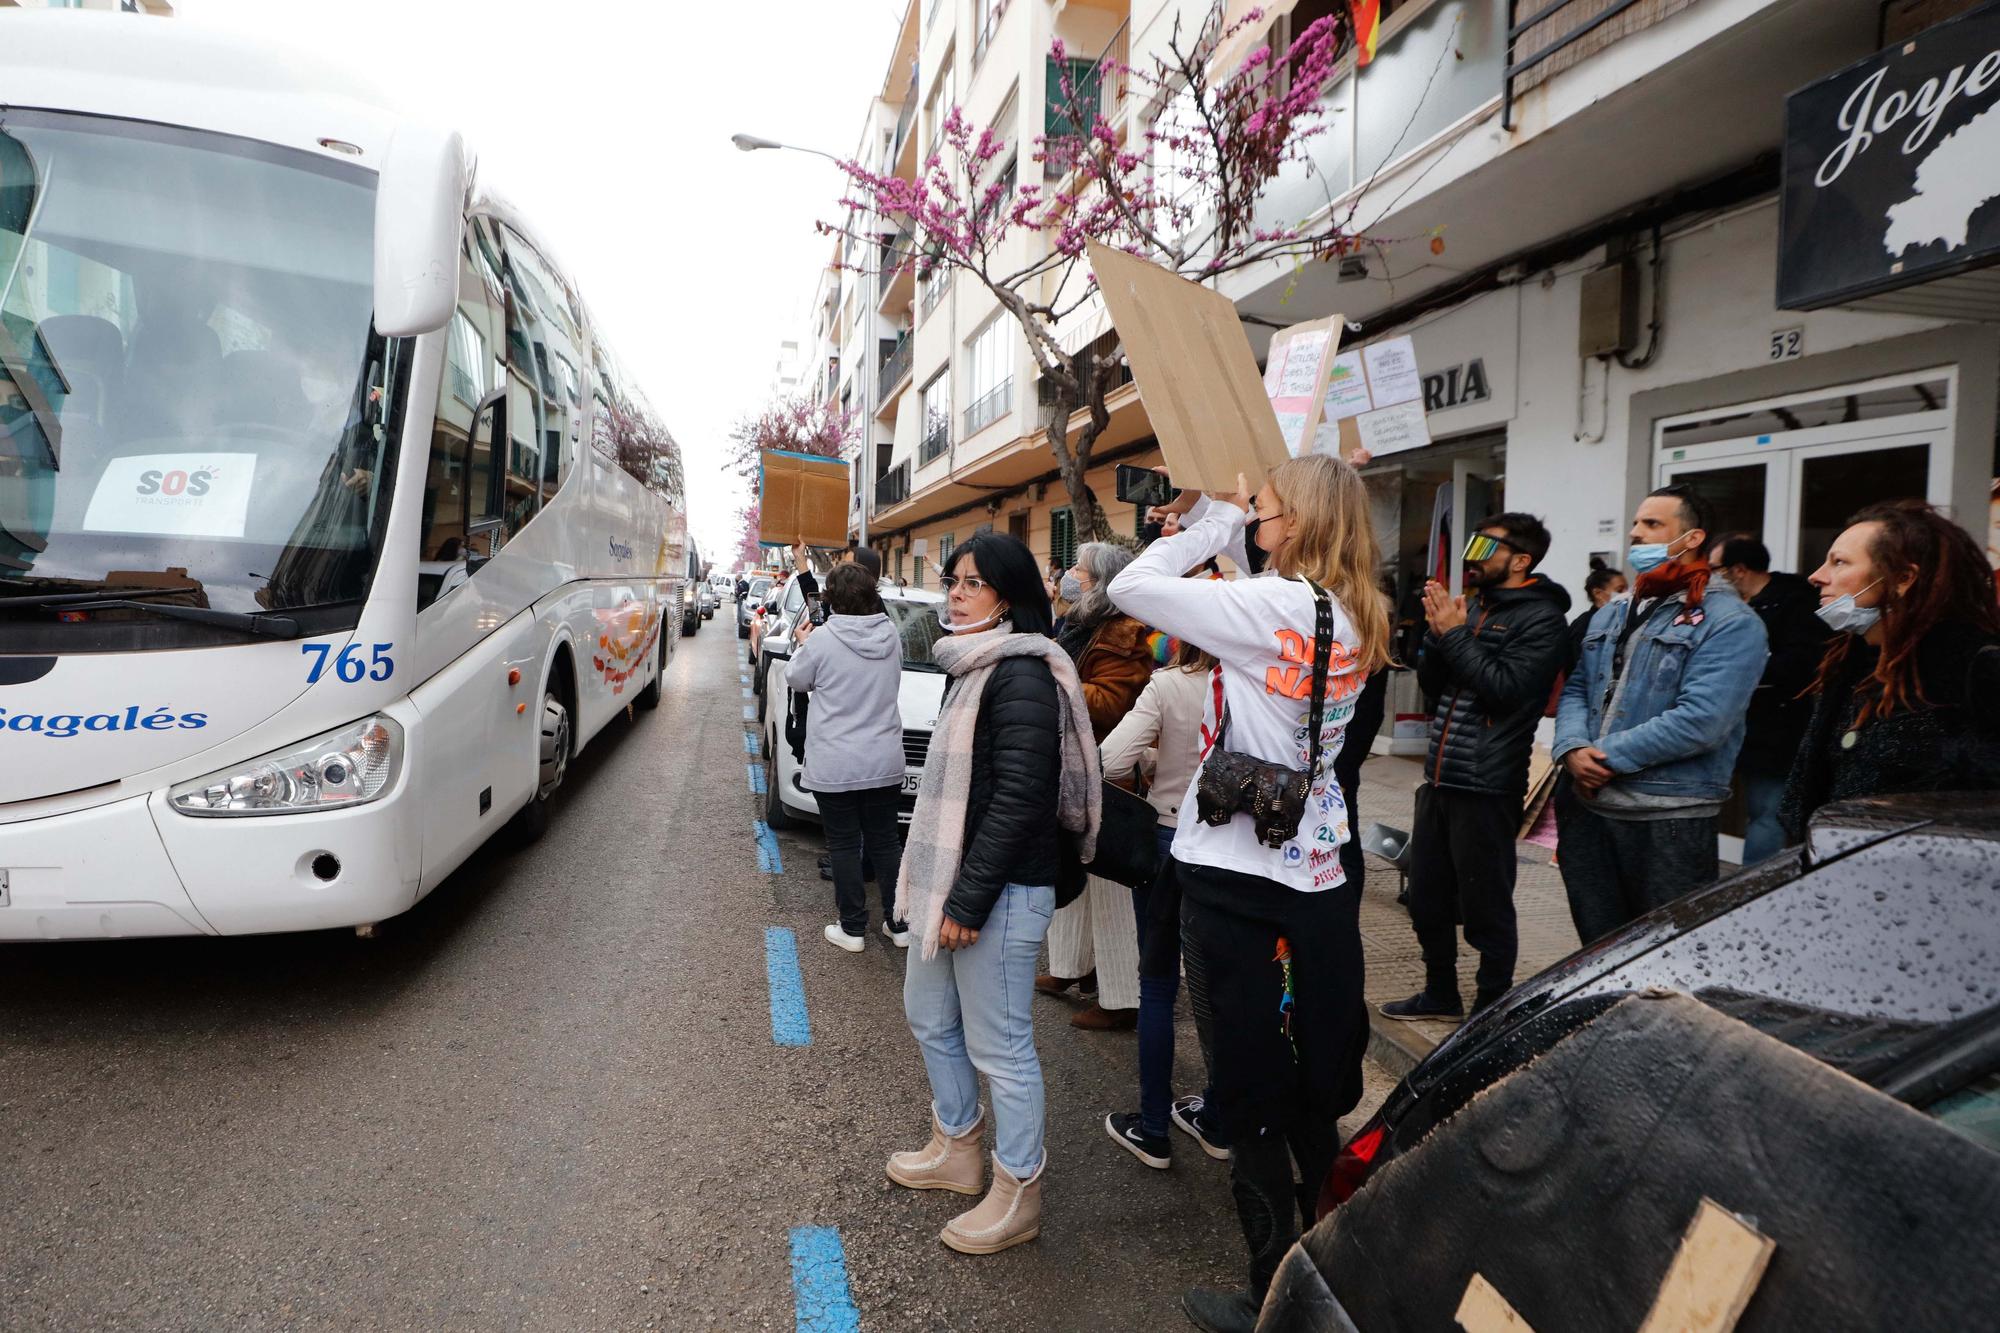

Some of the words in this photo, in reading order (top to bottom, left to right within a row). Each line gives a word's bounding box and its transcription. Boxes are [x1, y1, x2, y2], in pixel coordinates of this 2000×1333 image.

[1770, 331, 1800, 359] 52
[136, 470, 212, 496] SOS
[135, 496, 204, 506] TRANSPORTE
[302, 642, 394, 683] 765
[0, 706, 208, 738] agalés
